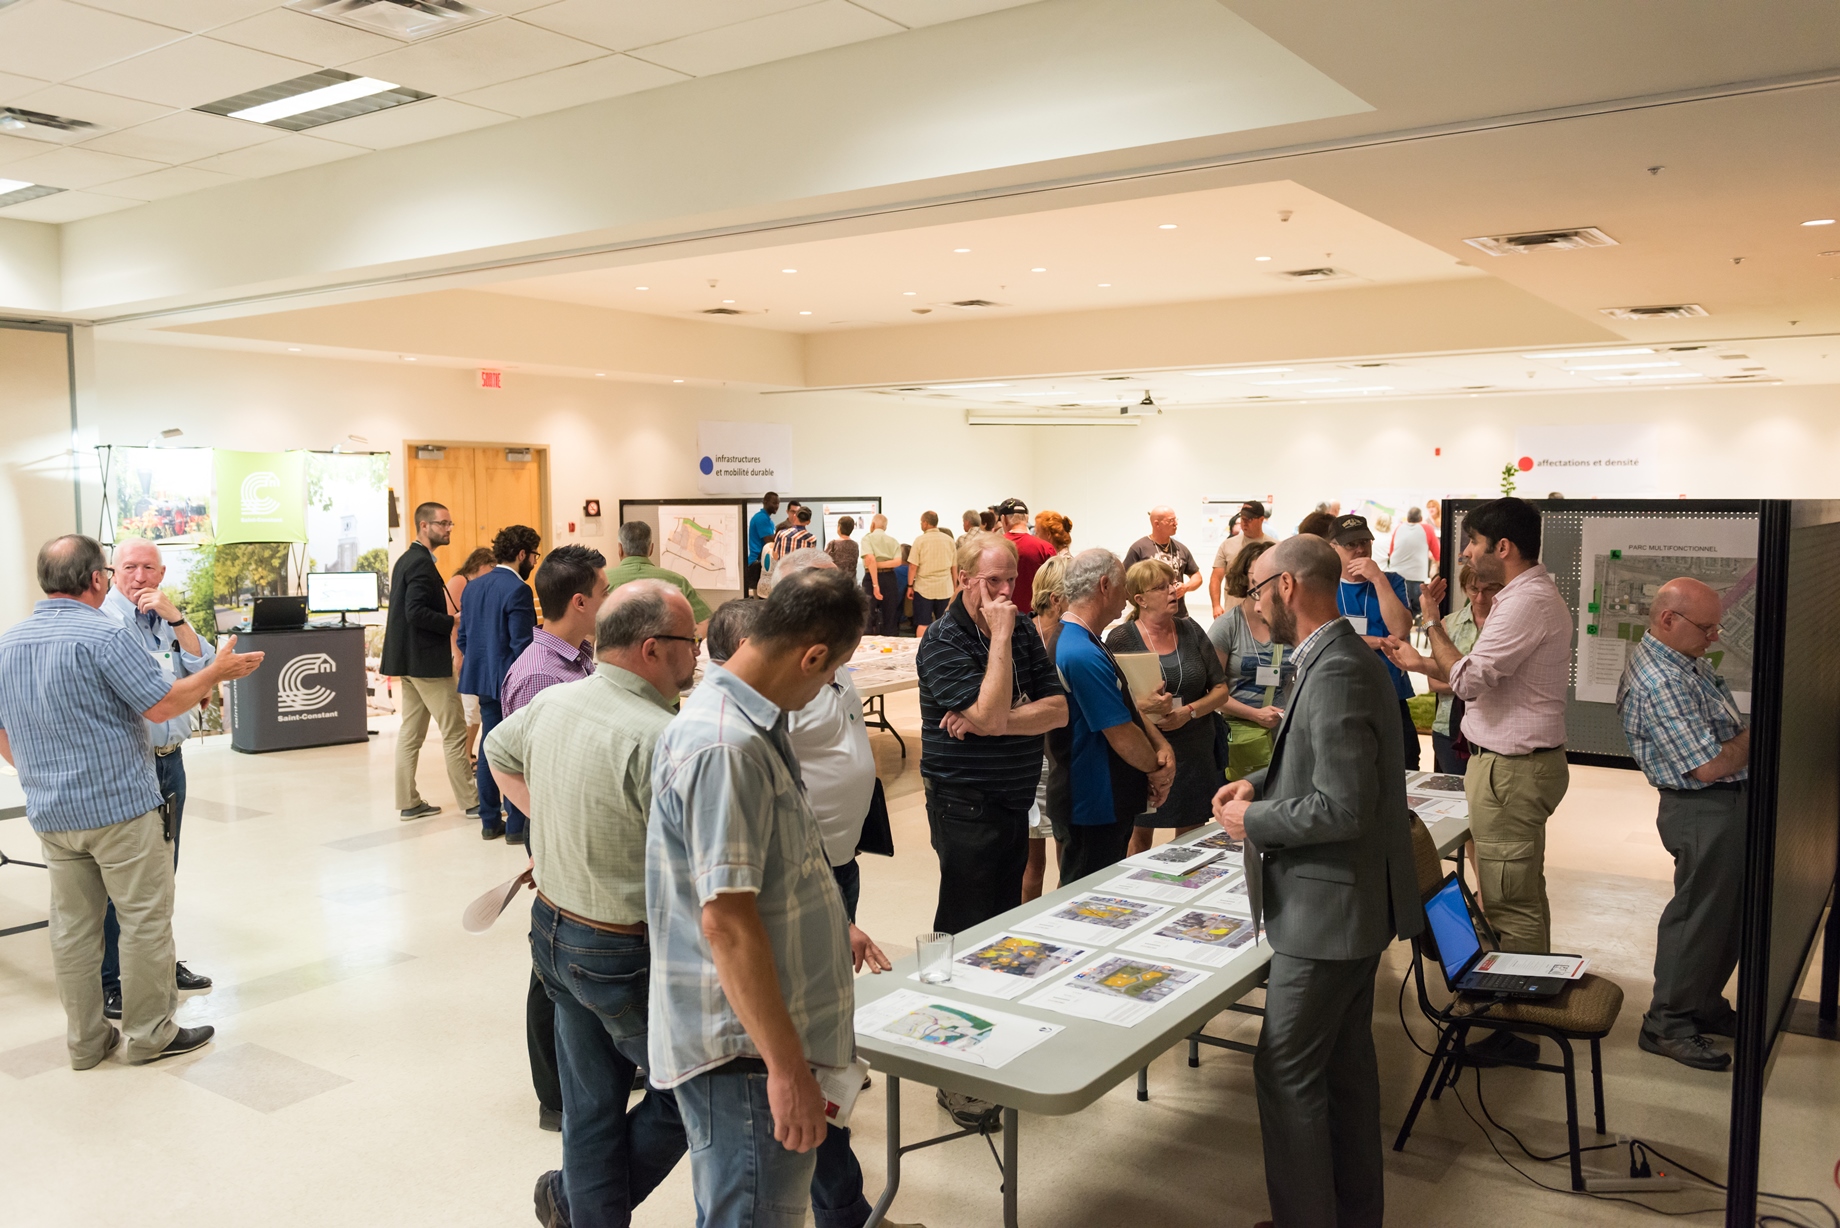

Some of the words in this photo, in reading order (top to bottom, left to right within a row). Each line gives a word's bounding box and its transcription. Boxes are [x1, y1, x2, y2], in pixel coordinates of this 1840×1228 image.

[715, 454, 761, 463] infrastructures
[1537, 459, 1591, 467] affectations
[1593, 459, 1602, 467] et
[1604, 458, 1640, 467] densité
[723, 468, 749, 476] mobilité
[750, 468, 774, 476] durable
[1648, 545, 1718, 553] MULTIFONCTIONNEL
[277, 711, 338, 722] Saint-Constant
